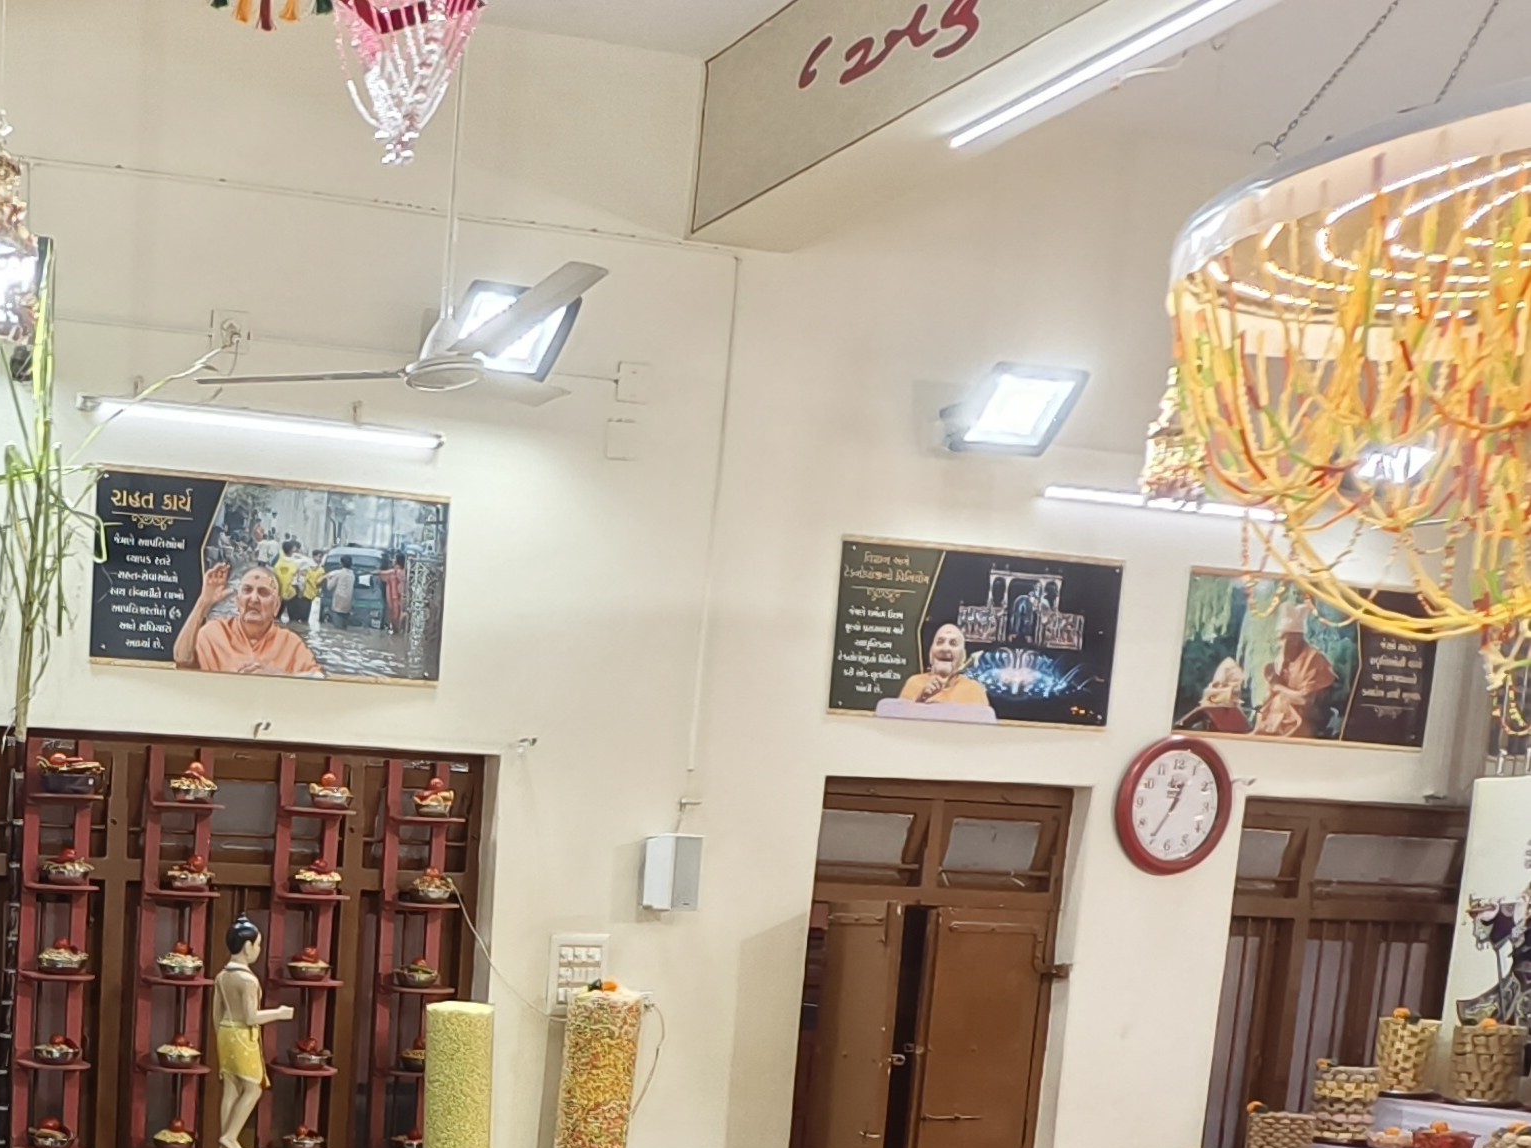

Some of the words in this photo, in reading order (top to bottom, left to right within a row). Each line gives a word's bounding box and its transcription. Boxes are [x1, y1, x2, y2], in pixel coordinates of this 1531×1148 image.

[111, 489, 154, 509] રાહત
[161, 488, 193, 512] કાર્ય
[1173, 758, 1186, 770] 12
